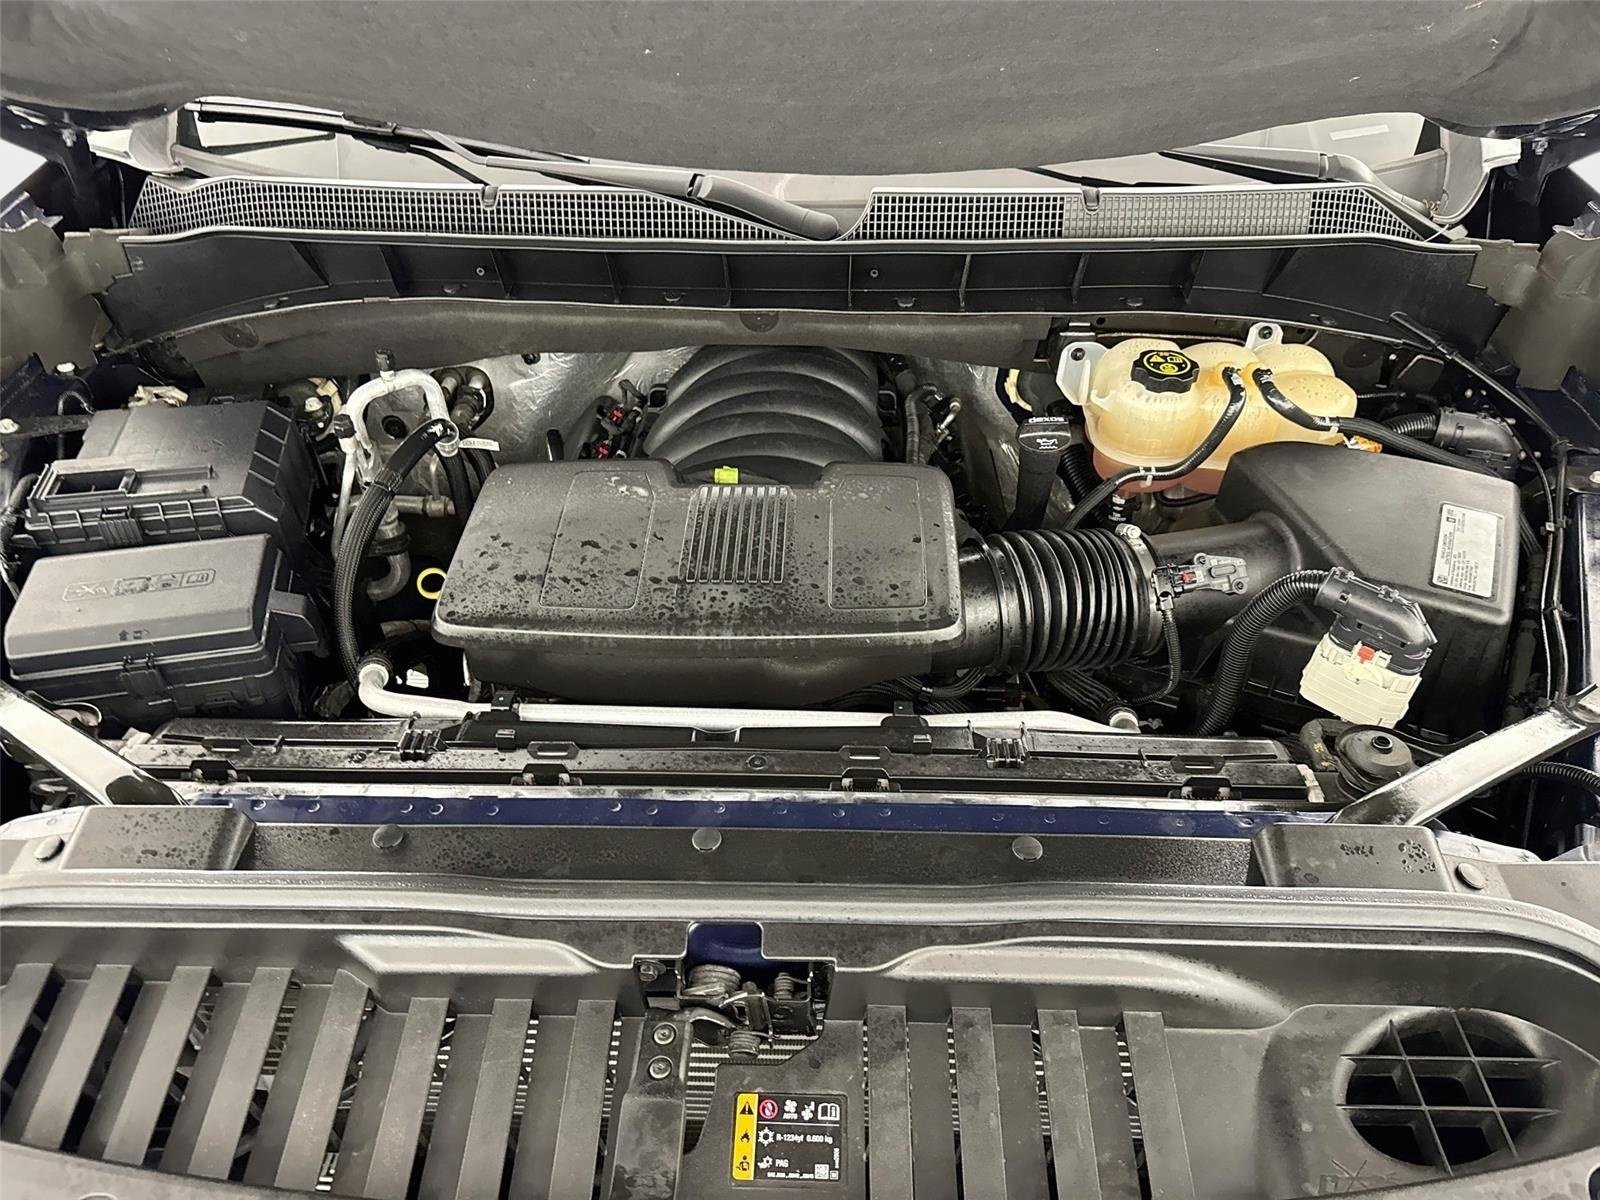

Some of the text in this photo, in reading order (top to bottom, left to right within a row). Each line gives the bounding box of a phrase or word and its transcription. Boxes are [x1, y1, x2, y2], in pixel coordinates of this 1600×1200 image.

[1028, 416, 1065, 424] dexos
[775, 1133, 804, 1143] R-1234yf
[824, 1135, 833, 1144] kg
[775, 1159, 789, 1168] PAG
